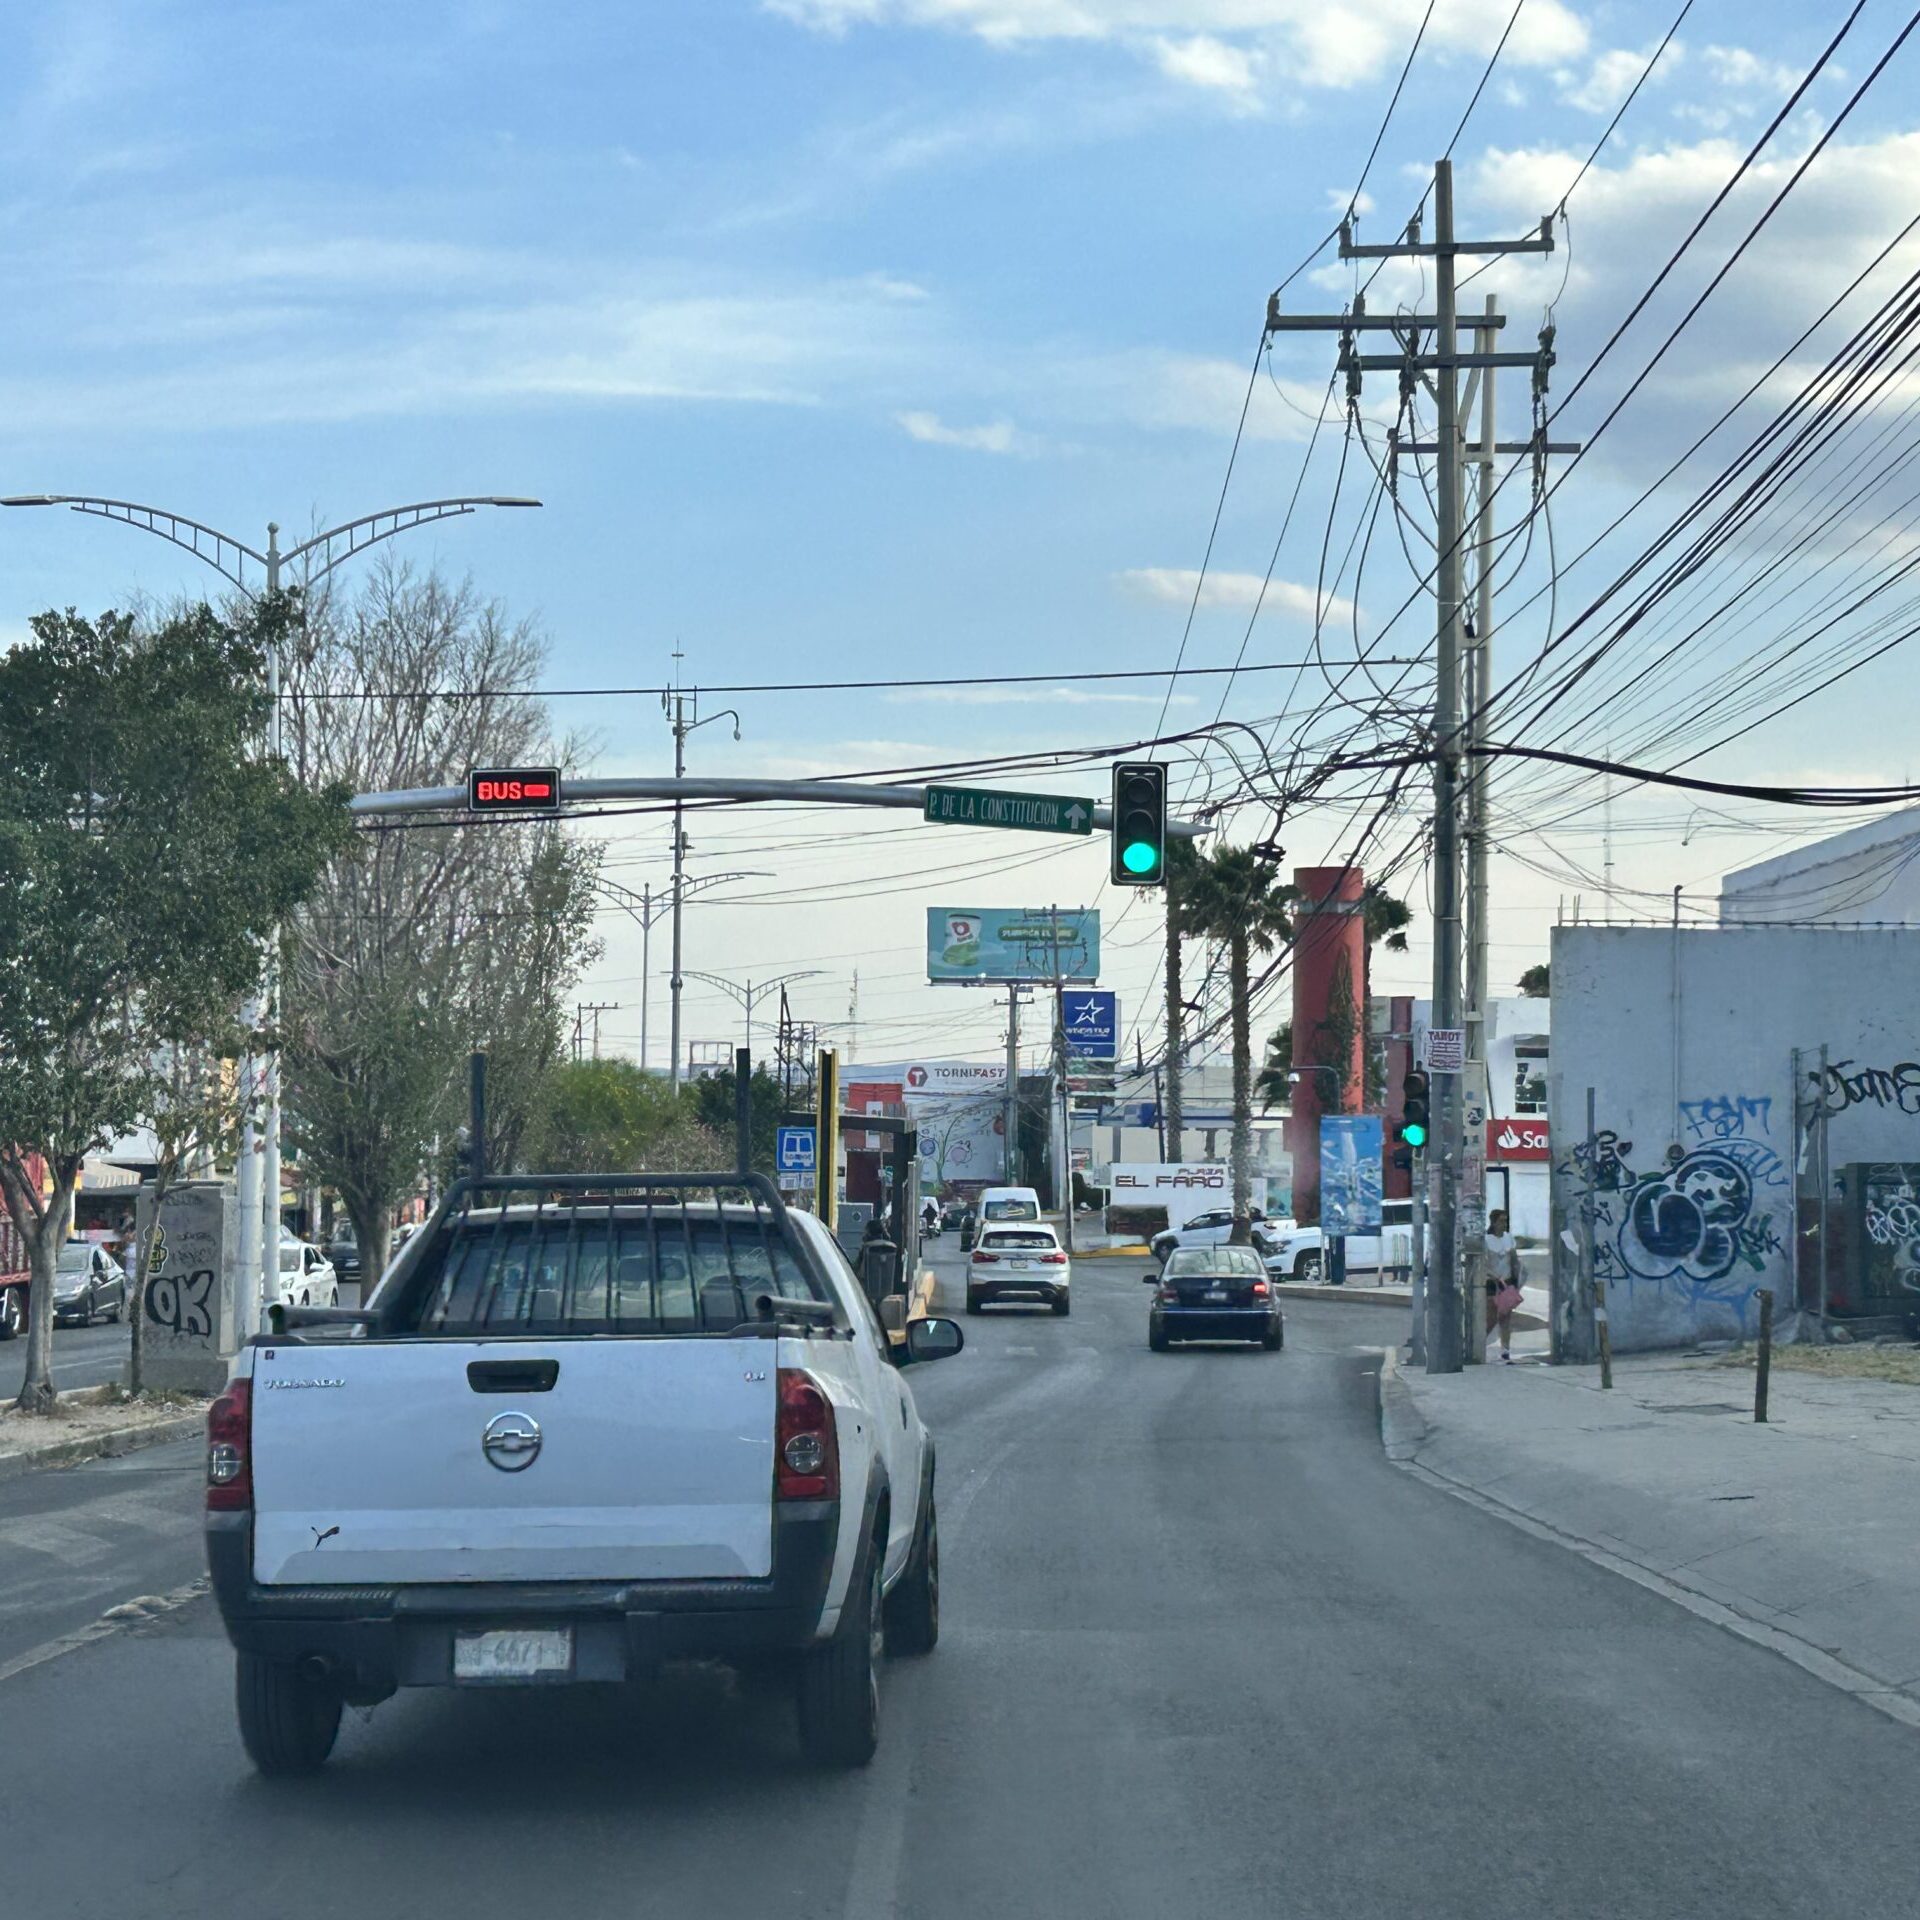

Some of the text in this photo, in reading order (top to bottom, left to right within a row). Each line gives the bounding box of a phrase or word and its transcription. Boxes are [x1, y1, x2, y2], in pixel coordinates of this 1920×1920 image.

[478, 781, 522, 800] BUS
[941, 796, 955, 817] DE
[960, 797, 975, 818] LA
[981, 798, 1059, 825] CONSTITUCION
[1522, 1130, 1549, 1149] Sa
[1114, 1175, 1224, 1188] EL FARO
[144, 1269, 215, 1338] OK
